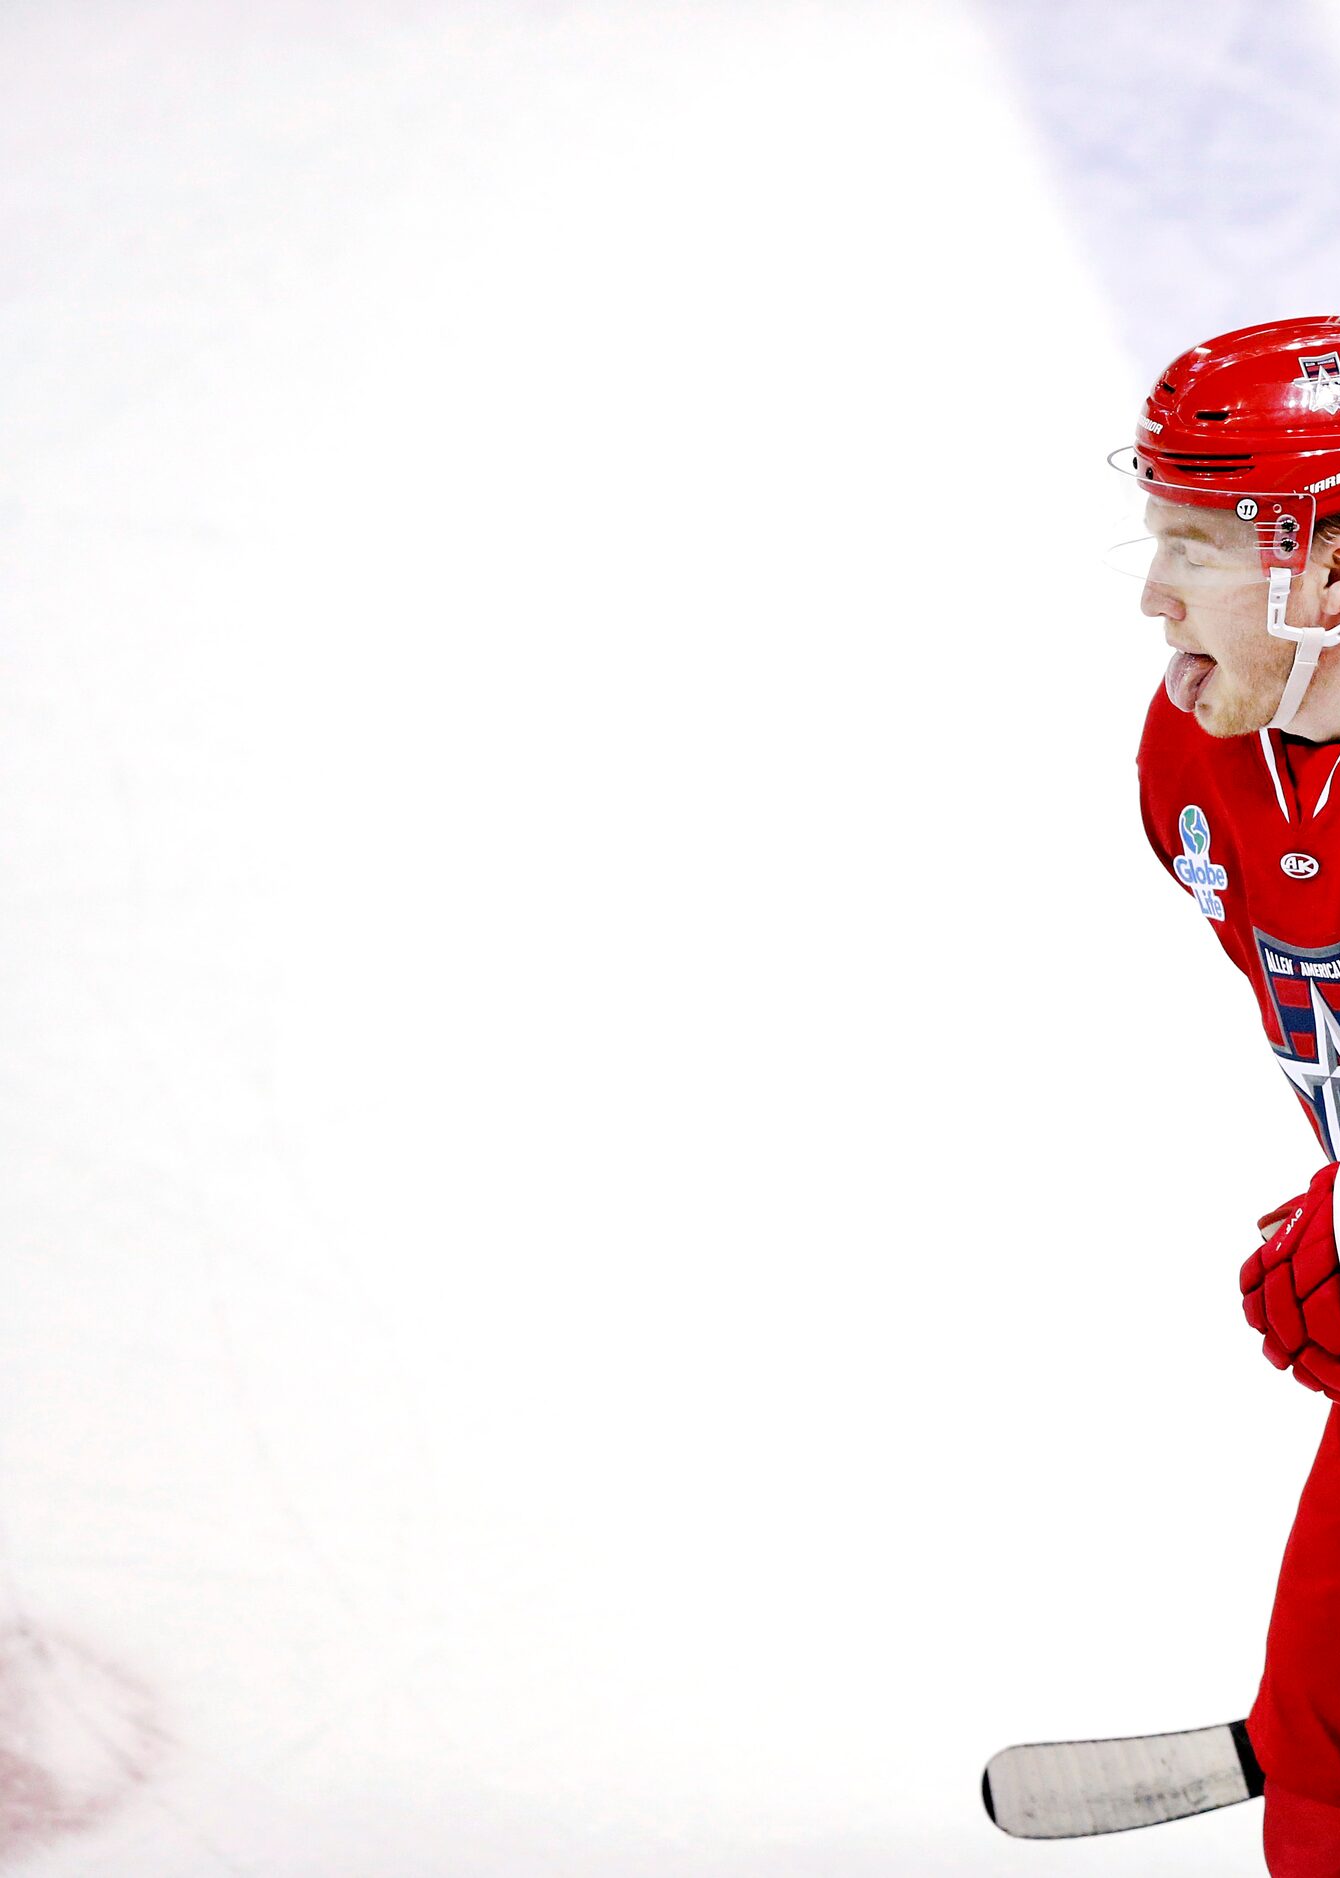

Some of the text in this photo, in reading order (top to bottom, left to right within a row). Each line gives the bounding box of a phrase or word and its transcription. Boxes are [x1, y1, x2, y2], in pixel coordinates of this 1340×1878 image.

[1138, 415, 1164, 435] RIOR
[1175, 857, 1226, 888] Globe
[1195, 887, 1223, 919] Life
[1264, 947, 1294, 976] ALLEN
